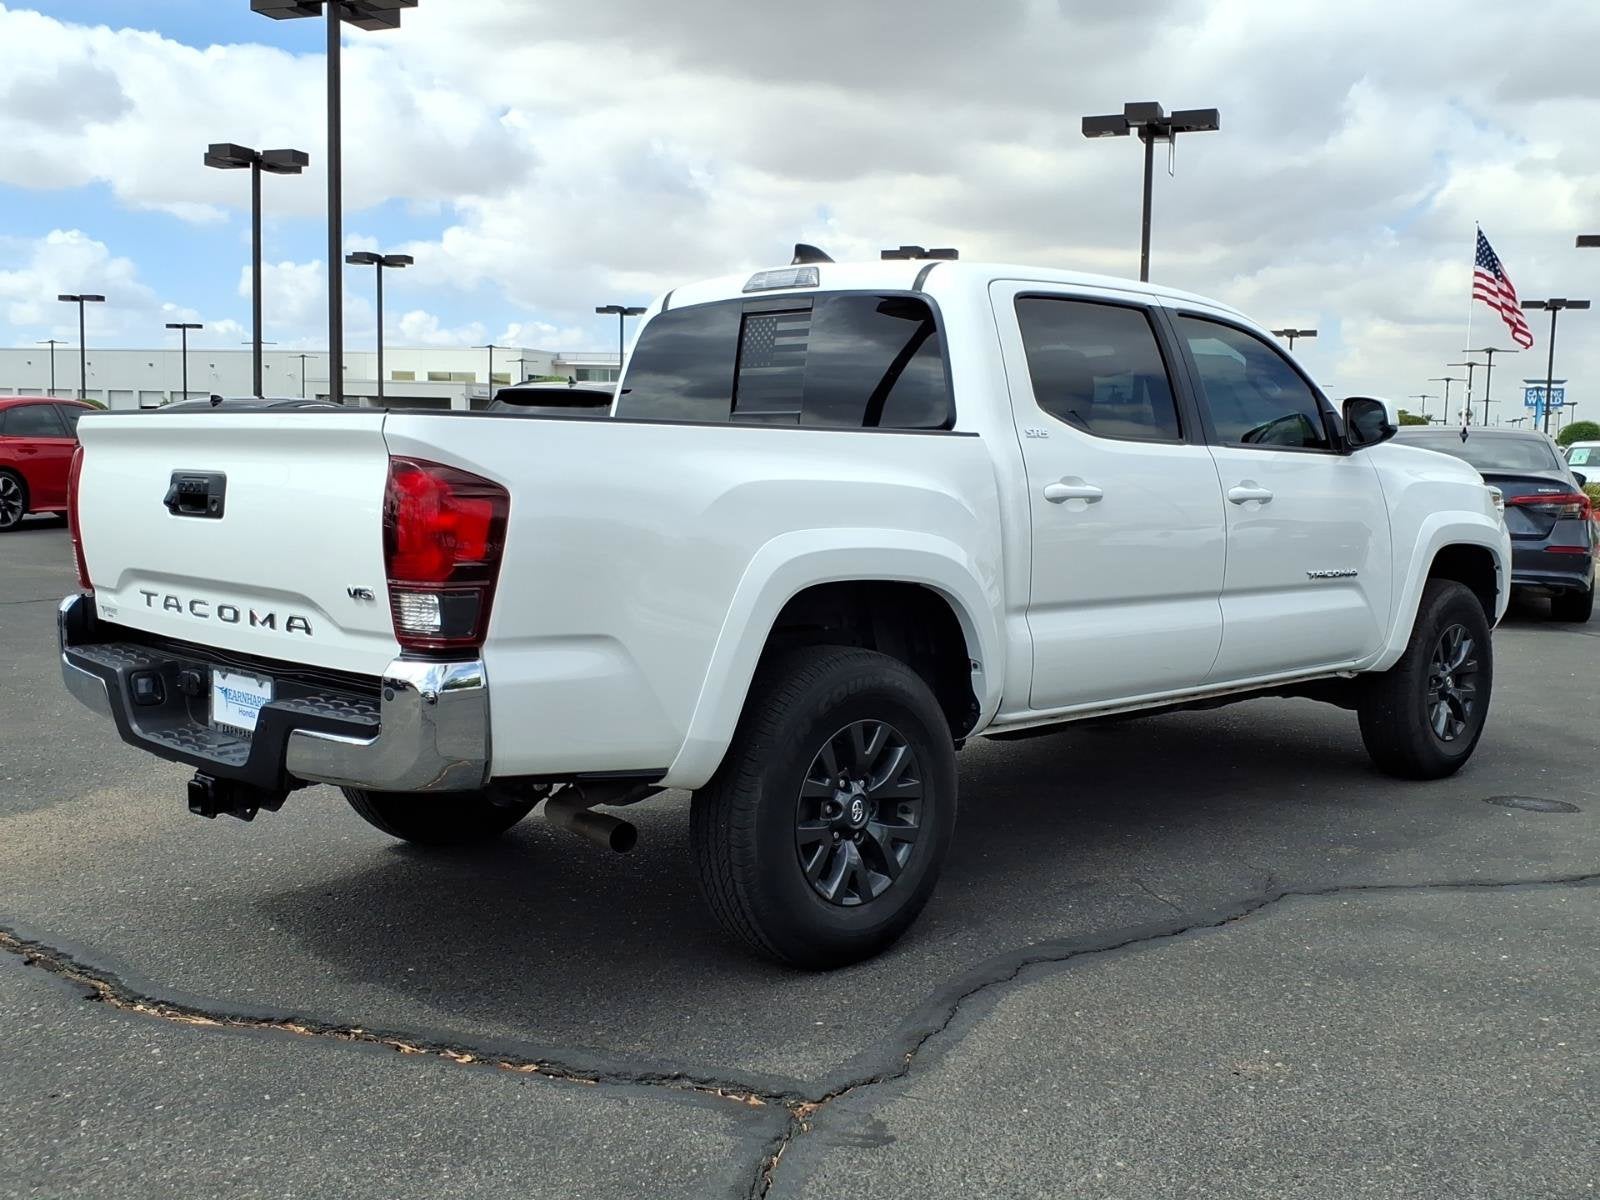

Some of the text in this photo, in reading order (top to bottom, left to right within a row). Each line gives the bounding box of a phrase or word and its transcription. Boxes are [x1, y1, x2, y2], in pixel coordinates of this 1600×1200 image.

[1306, 568, 1358, 580] TACOMA
[347, 585, 376, 601] V6
[139, 589, 313, 636] TACOMA
[228, 688, 269, 707] EARNHAR
[239, 707, 256, 719] Honda
